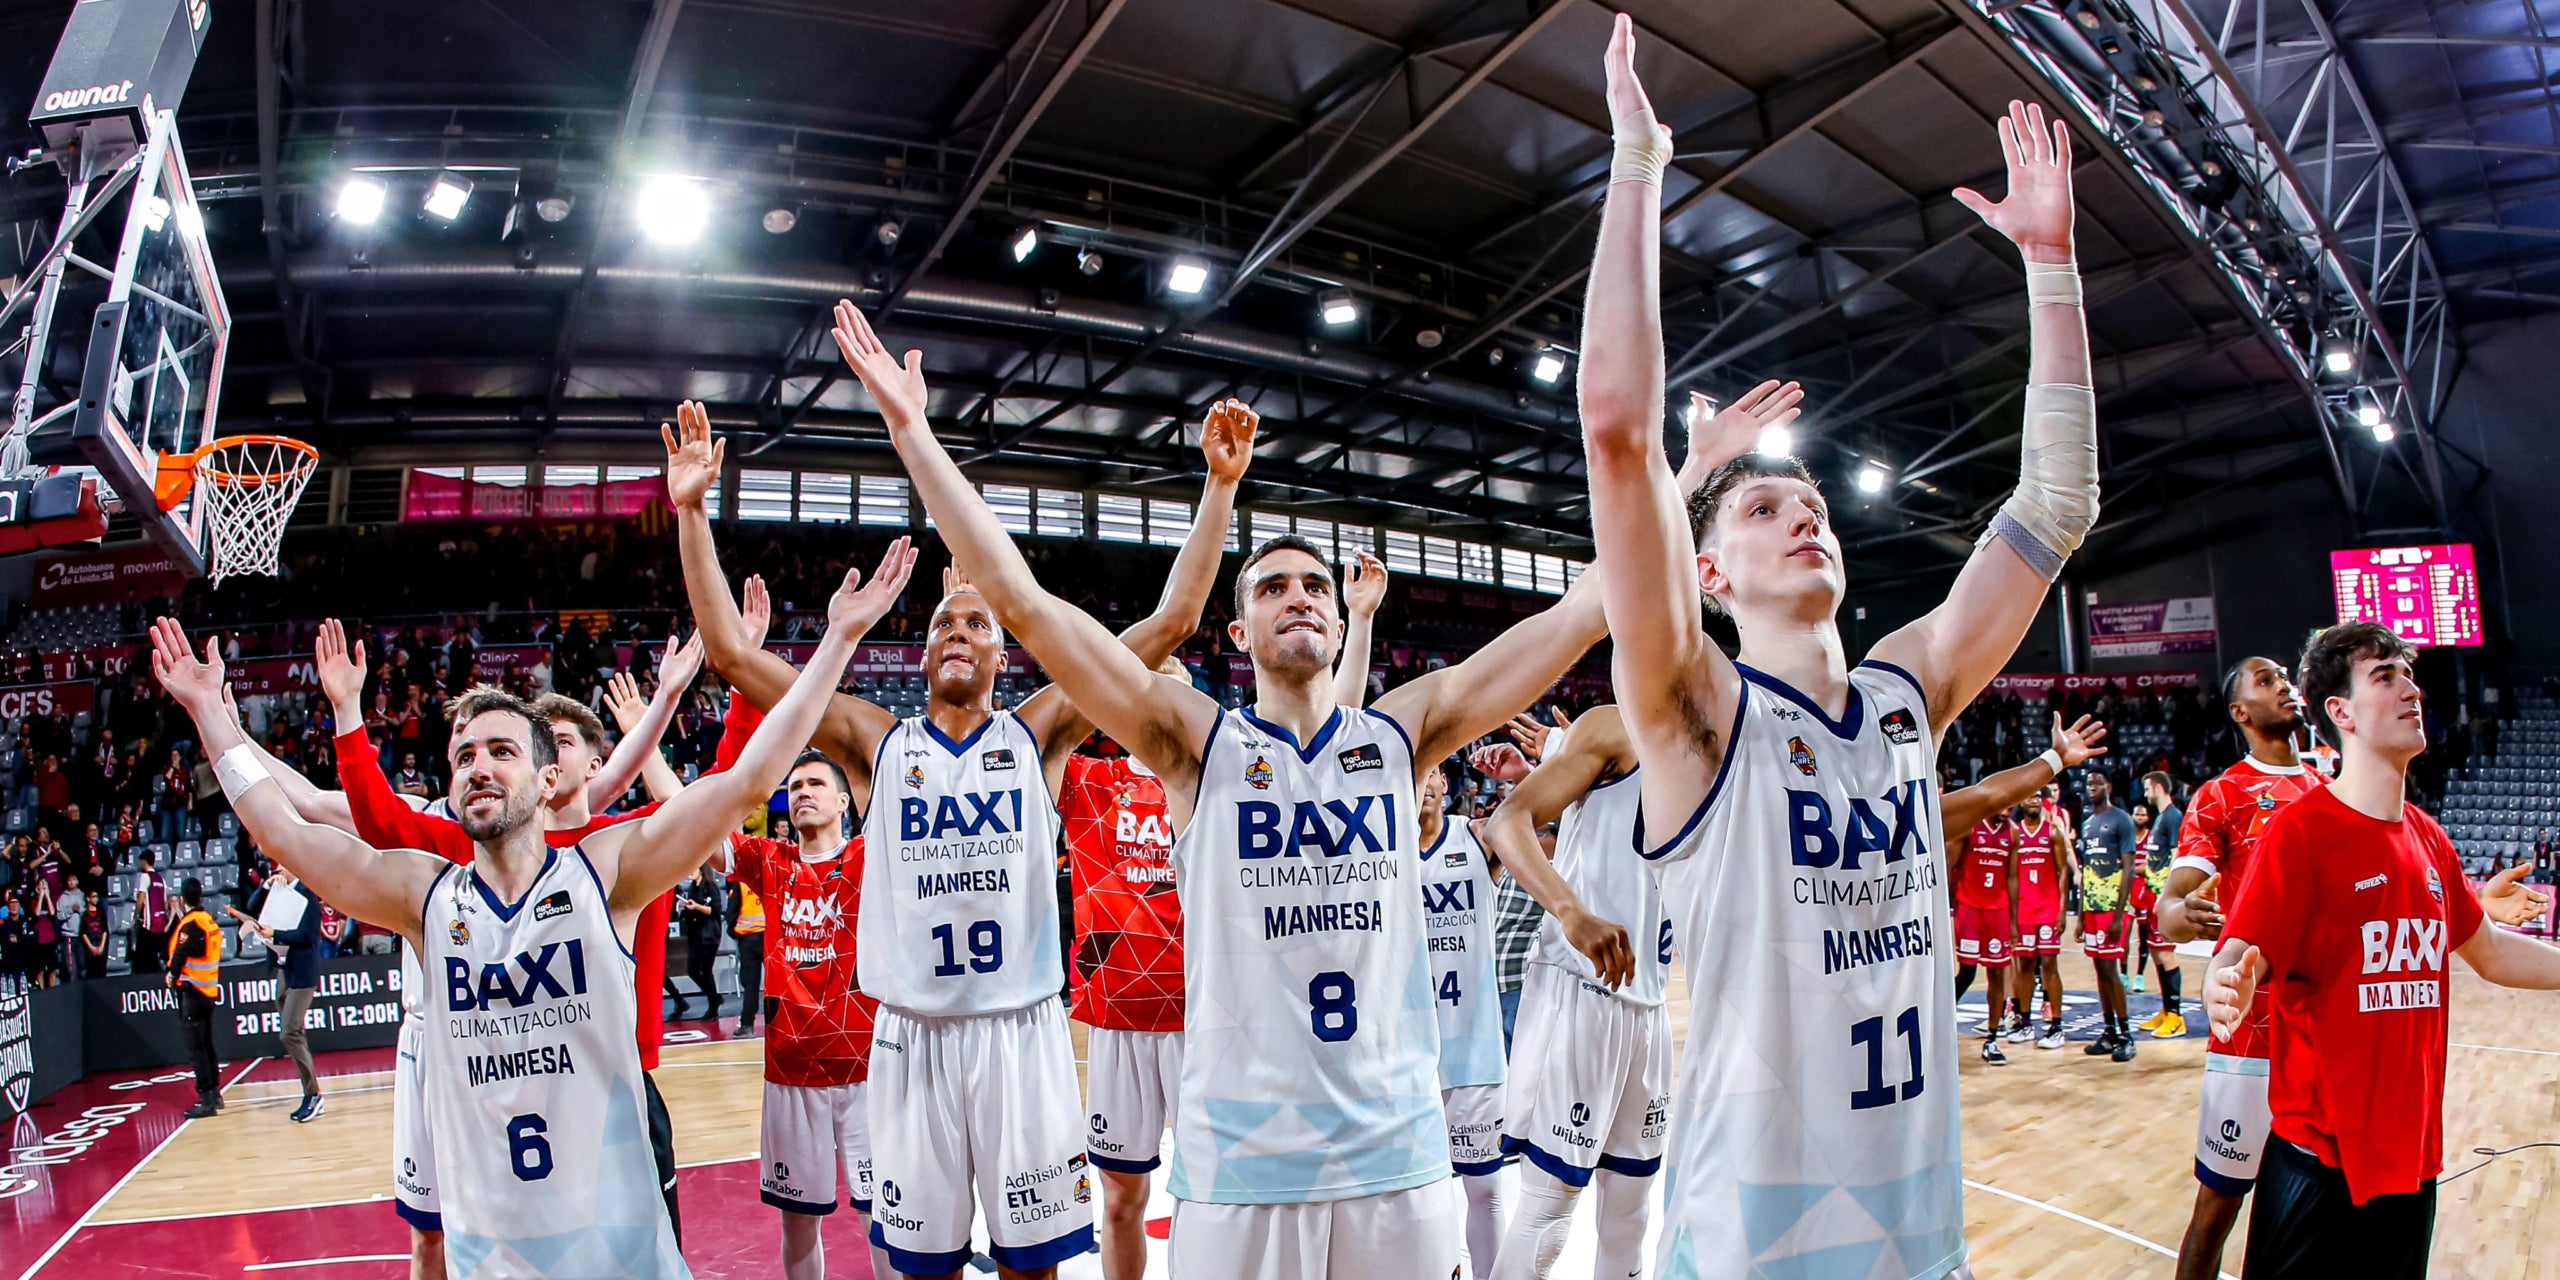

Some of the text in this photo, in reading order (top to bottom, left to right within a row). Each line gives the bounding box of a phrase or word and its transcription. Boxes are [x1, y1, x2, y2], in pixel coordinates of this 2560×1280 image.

[44, 80, 133, 112] ownat
[869, 649, 903, 663] Pujol
[1884, 722, 1903, 734] liga
[1343, 755, 1361, 766] liga
[1346, 759, 1382, 771] endesa
[900, 788, 1023, 841] BAXI
[1116, 809, 1172, 846] BA
[1235, 794, 1396, 860] BAXI
[1784, 778, 1930, 870] BAXI
[900, 835, 1024, 863] CLIMATIZACIÓN
[1115, 844, 1170, 861] CLIMATIZ
[917, 869, 1011, 900] MANRESA
[1126, 866, 1176, 884] MANRE
[1240, 857, 1398, 889] CLIMATIZACIÓN
[1984, 872, 1994, 888] 3
[2029, 869, 2038, 884] 4
[1264, 900, 1383, 941] MANRESA
[1426, 912, 1477, 930] TIZACIÓN
[932, 919, 1004, 977] 19
[1427, 935, 1467, 952] RESA
[2360, 918, 2447, 975] BAXI
[444, 938, 588, 1013] BAXI
[1433, 970, 1462, 1009] 4
[121, 988, 179, 1014] JORNA
[1309, 970, 1358, 1043] 8
[236, 1002, 399, 1035] 20 FEER 12:00H
[450, 999, 593, 1039] CLIMATIZACIÓN
[467, 1043, 576, 1088] MANRESA
[1850, 1006, 1925, 1110] 11
[1646, 1092, 1671, 1112] Adbi
[507, 1113, 554, 1181] 6
[1452, 1135, 1474, 1147] ETL
[2205, 1135, 2251, 1162] unilabor
[859, 1170, 873, 1183] ET
[1005, 1163, 1063, 1190] Adbisio
[1008, 1190, 1043, 1209] ETL
[1011, 1199, 1070, 1225] GLOBAL
